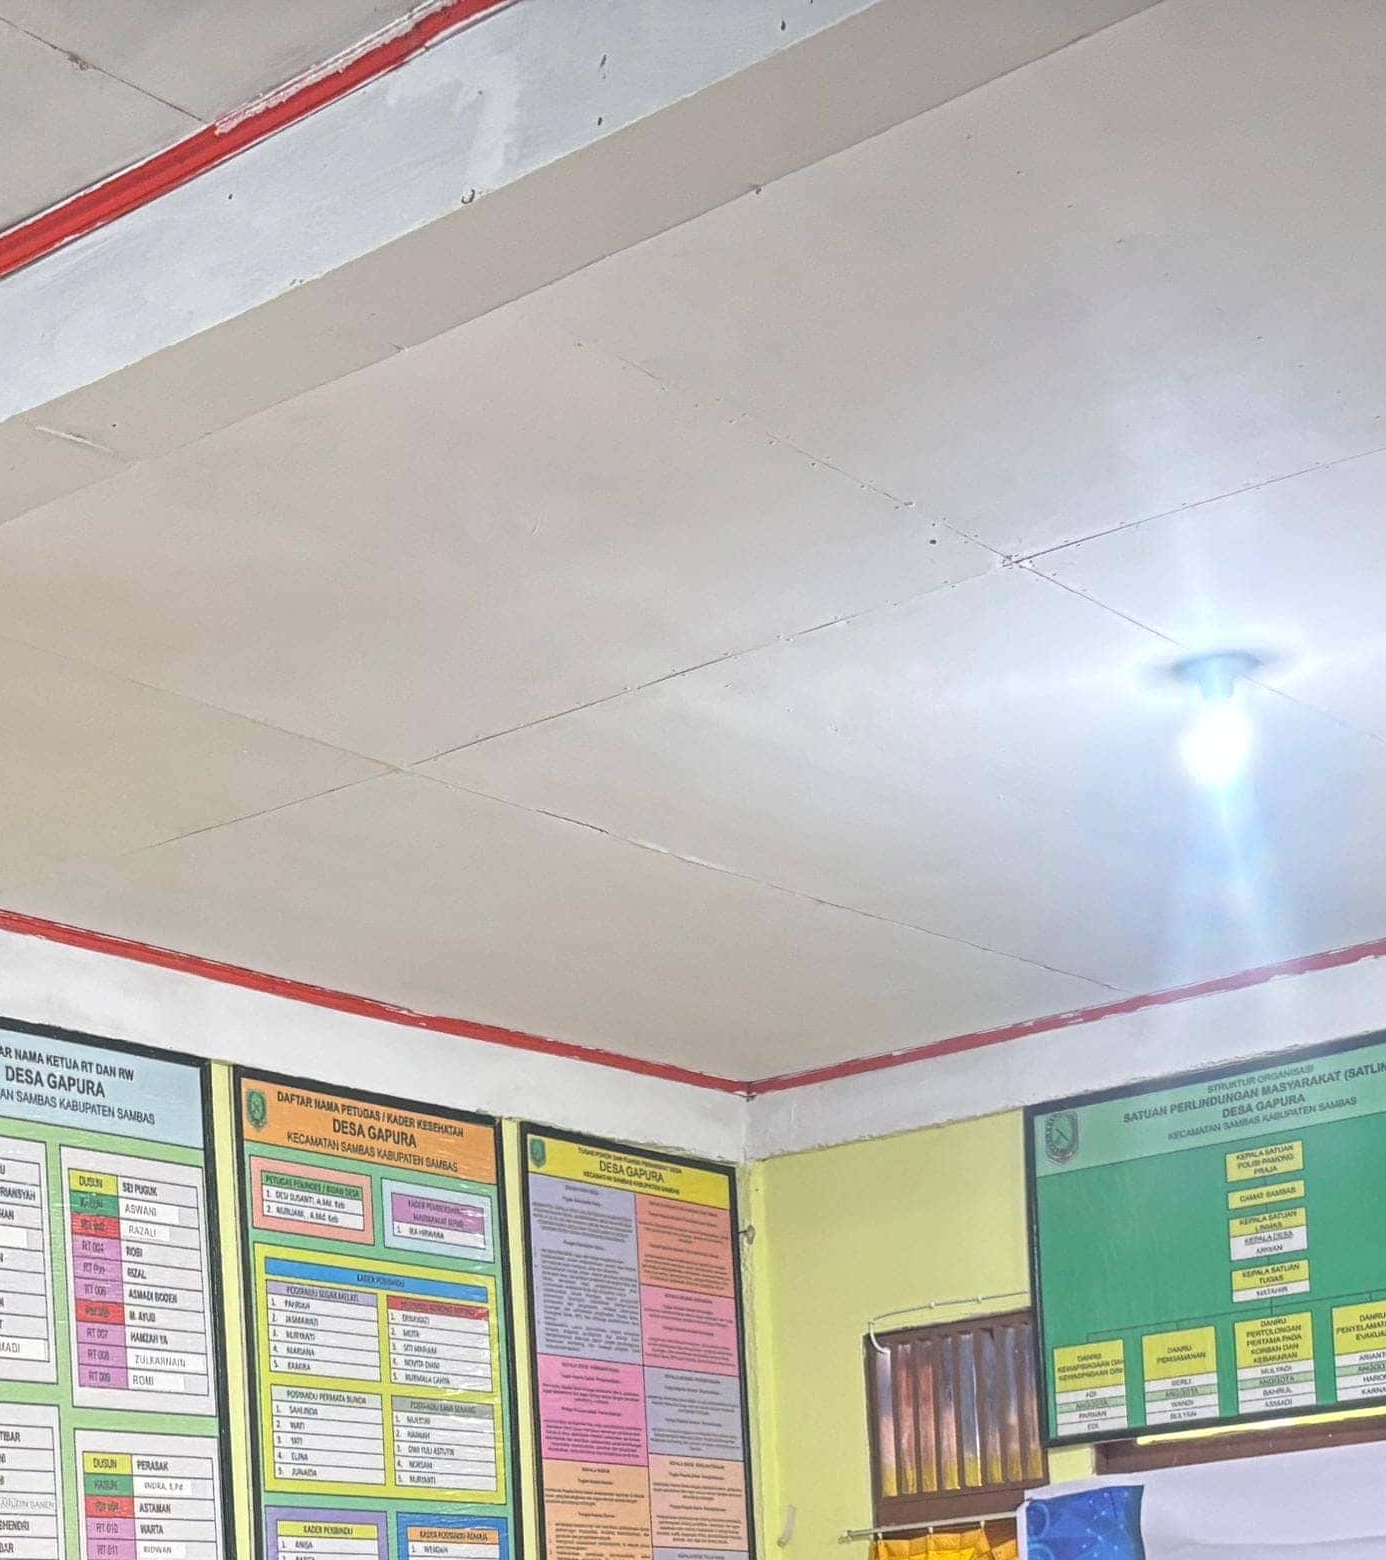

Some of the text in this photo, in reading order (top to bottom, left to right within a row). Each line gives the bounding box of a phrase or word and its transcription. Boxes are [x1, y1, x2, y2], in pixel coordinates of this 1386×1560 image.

[15, 1048, 44, 1064] NAMA
[46, 1054, 79, 1071] KETUA
[82, 1060, 93, 1073] RT
[96, 1062, 116, 1077] DAN
[119, 1067, 133, 1081] RW
[5, 1066, 105, 1098] DESA GAPURA
[1123, 1105, 1167, 1123] SATUAN
[1169, 1087, 1258, 1116] PERLINDUNGAN
[1261, 1070, 1342, 1097] MASYARAKAT
[1206, 1076, 1256, 1093] STRUKTUR
[16, 1090, 57, 1108] SAMBAS
[60, 1096, 115, 1117] KABUPATEN
[117, 1107, 155, 1125] SAMBAS
[277, 1091, 312, 1108] DAFTAR
[314, 1098, 340, 1113] NAMA
[341, 1104, 380, 1121] PETUGAS
[386, 1111, 414, 1128] KADER
[417, 1118, 463, 1137] KESEHATAN
[1168, 1096, 1357, 1140] KECAMATAN SAMBAS KABUPATEN SAMBAS
[1222, 1093, 1305, 1119] DESA GAPURA
[333, 1119, 417, 1148] DESA GAPURA
[287, 1131, 458, 1172] KECAMATAN SAMBAS KABUPATEN SAMBAS
[600, 1160, 625, 1174] DESA
[627, 1166, 664, 1182] GAPURA
